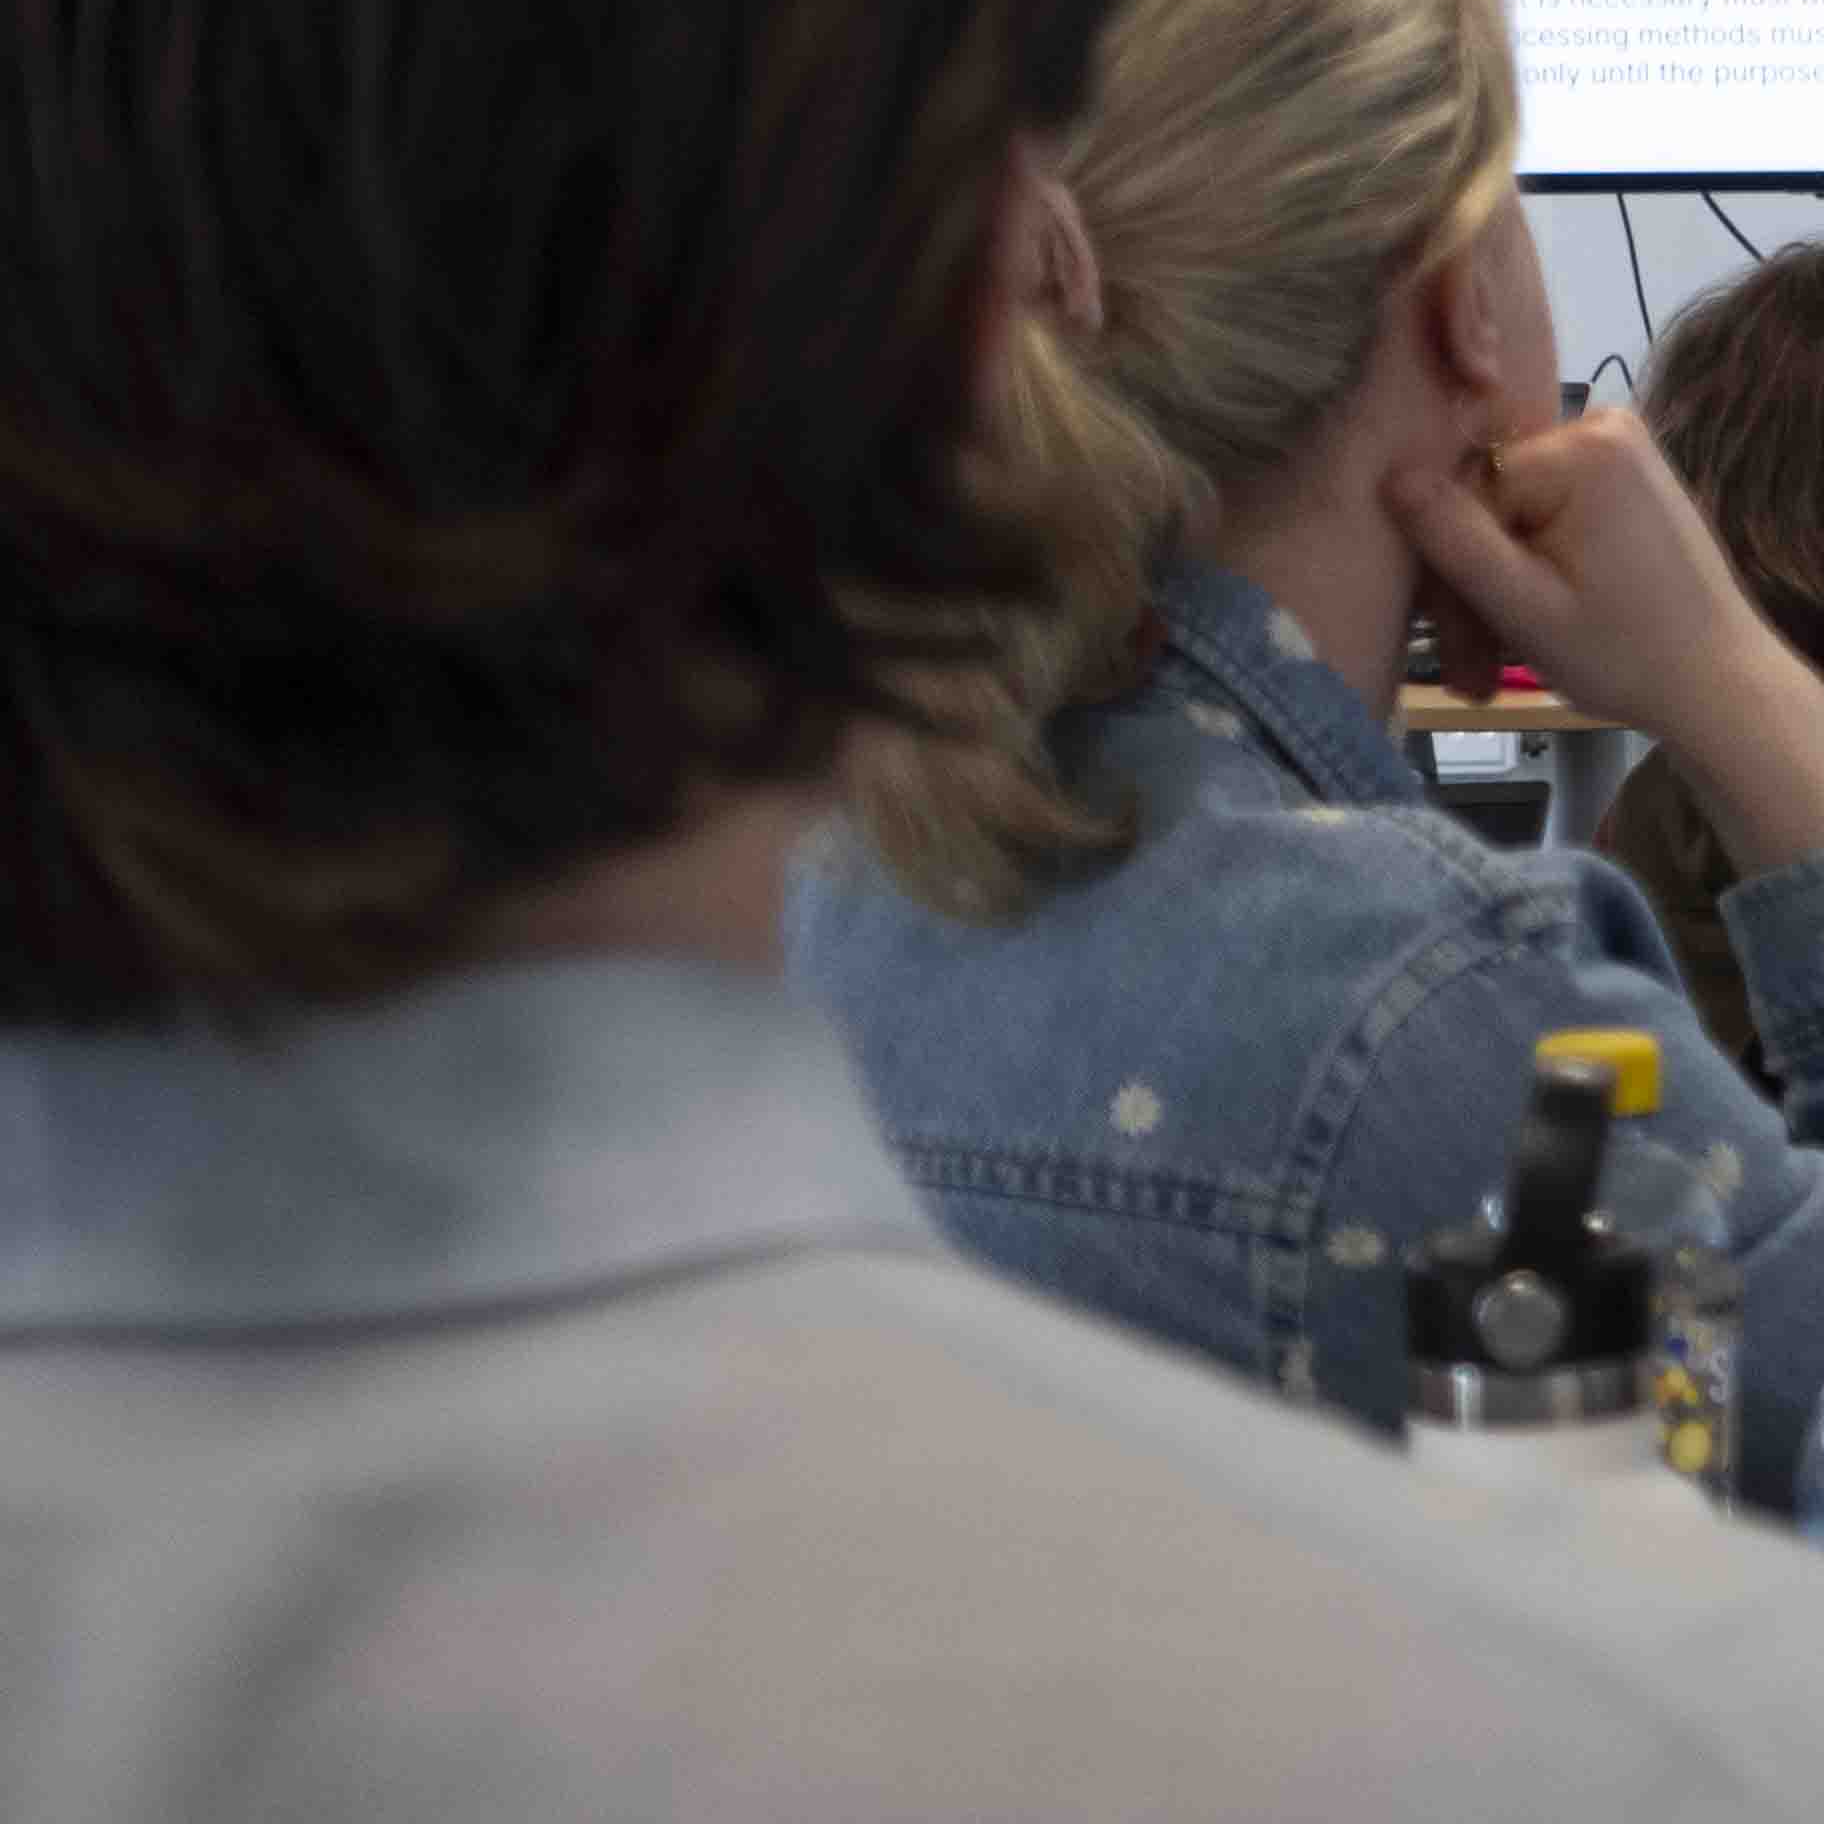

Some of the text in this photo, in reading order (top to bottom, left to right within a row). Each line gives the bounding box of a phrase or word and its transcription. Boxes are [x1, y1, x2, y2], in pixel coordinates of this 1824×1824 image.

[1638, 21, 1762, 48] methods
[1591, 61, 1650, 86] until
[1658, 60, 1705, 85] the
